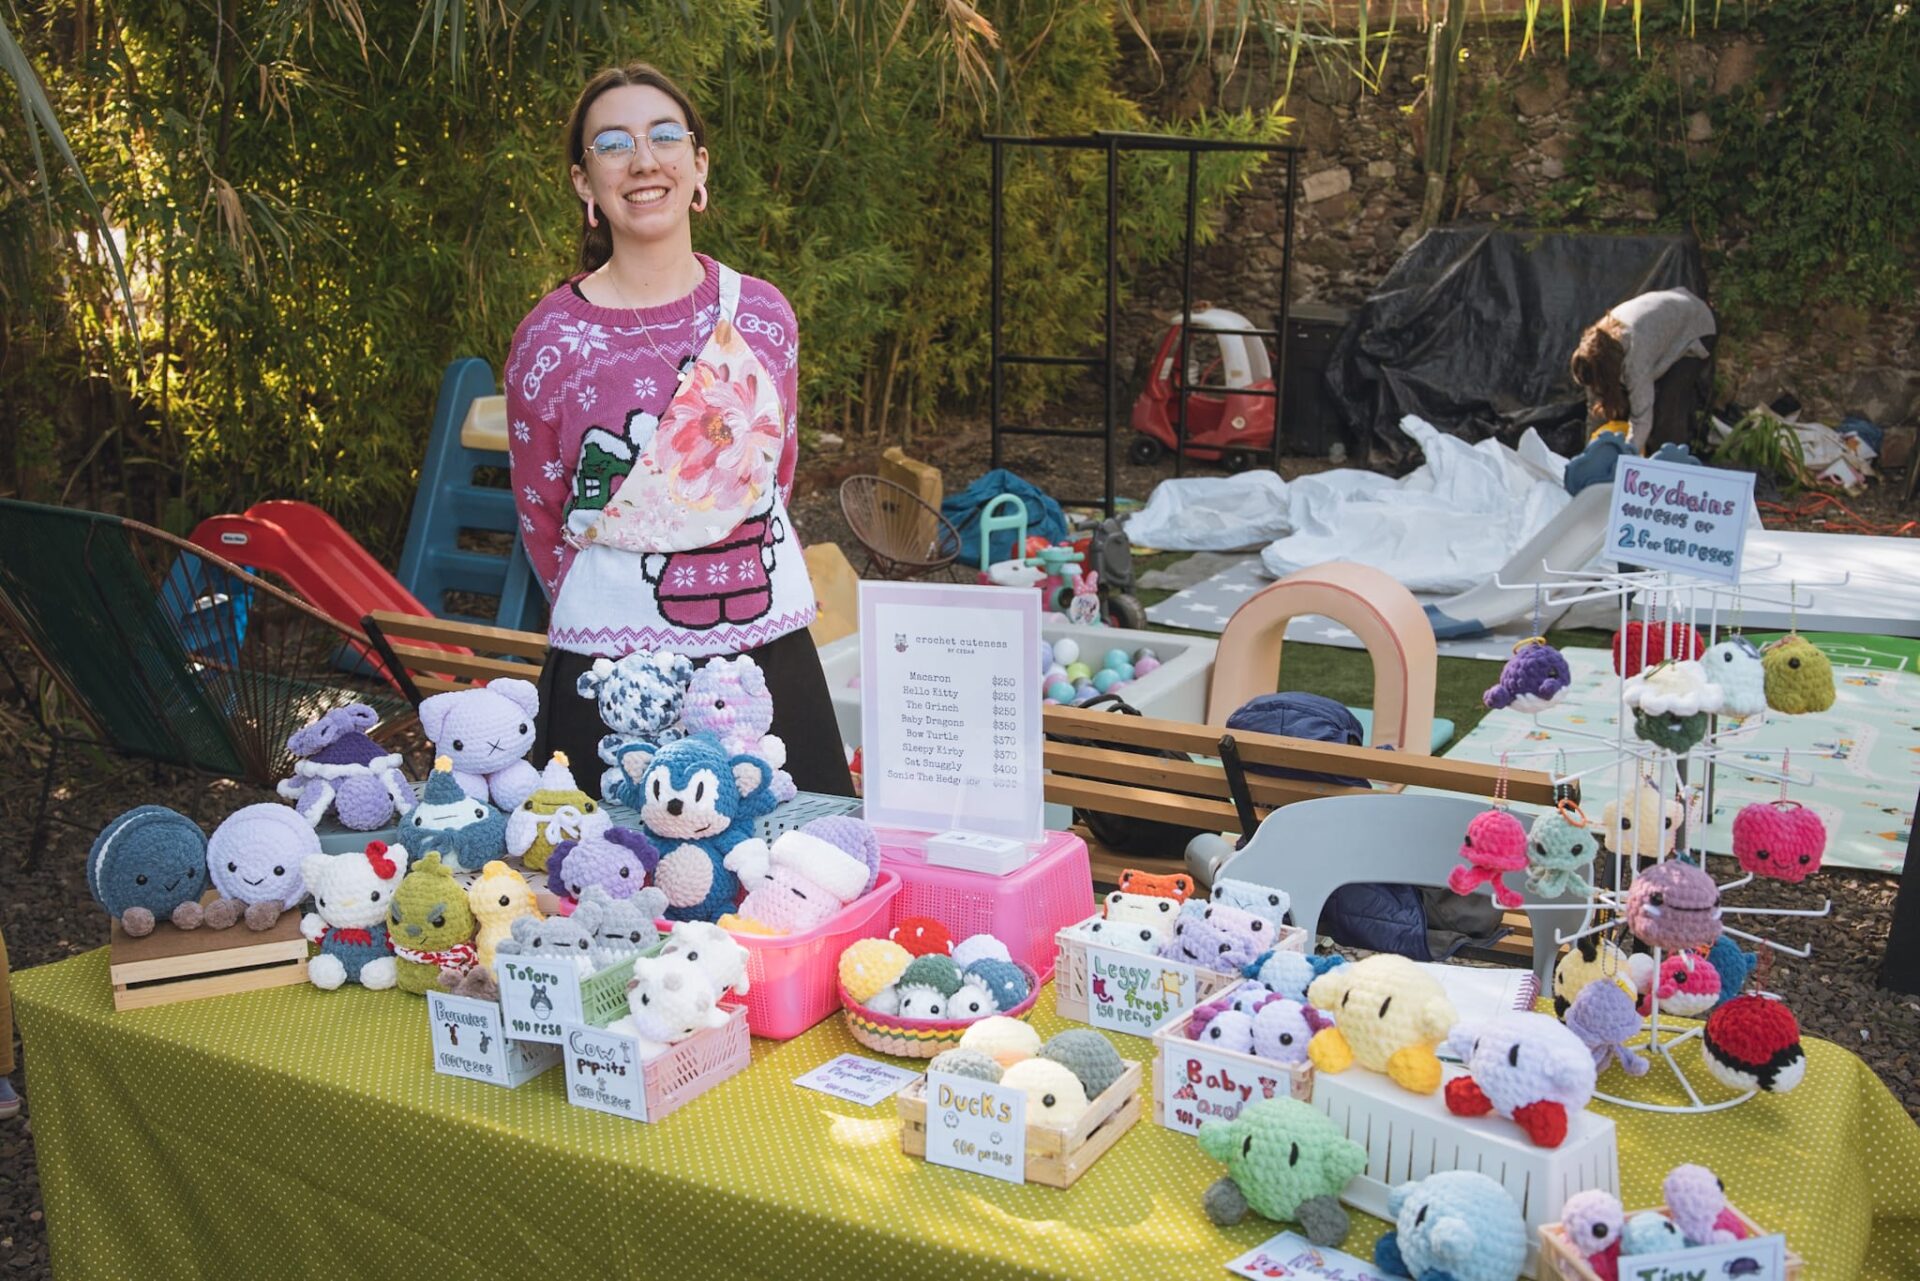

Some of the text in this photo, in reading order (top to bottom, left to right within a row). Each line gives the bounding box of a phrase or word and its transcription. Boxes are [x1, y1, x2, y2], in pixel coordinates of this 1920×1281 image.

[1623, 468, 1735, 516] Keychains
[1618, 523, 1635, 548] 2
[916, 636, 1008, 648] crochet cuteness
[910, 672, 1016, 687] Macaron $250
[903, 686, 1016, 702] Hello Kitty $250
[906, 700, 1016, 717] The Grinch $250
[901, 714, 1016, 732] Baby Dragons $350
[906, 729, 1016, 746] Bow Turtle $370
[902, 743, 1016, 760] Sleepy Kirby $370
[887, 770, 914, 780] Sonic
[917, 772, 934, 782] The
[904, 758, 1018, 775] Cat Snuggly $400
[505, 963, 558, 986] Totoro
[1094, 956, 1152, 990] Leggy
[1124, 986, 1169, 1020] frogs
[435, 1000, 488, 1028] Bunnies
[570, 1031, 616, 1061] Cow
[1187, 1058, 1252, 1102] Baby
[1197, 1099, 1243, 1121] axol
